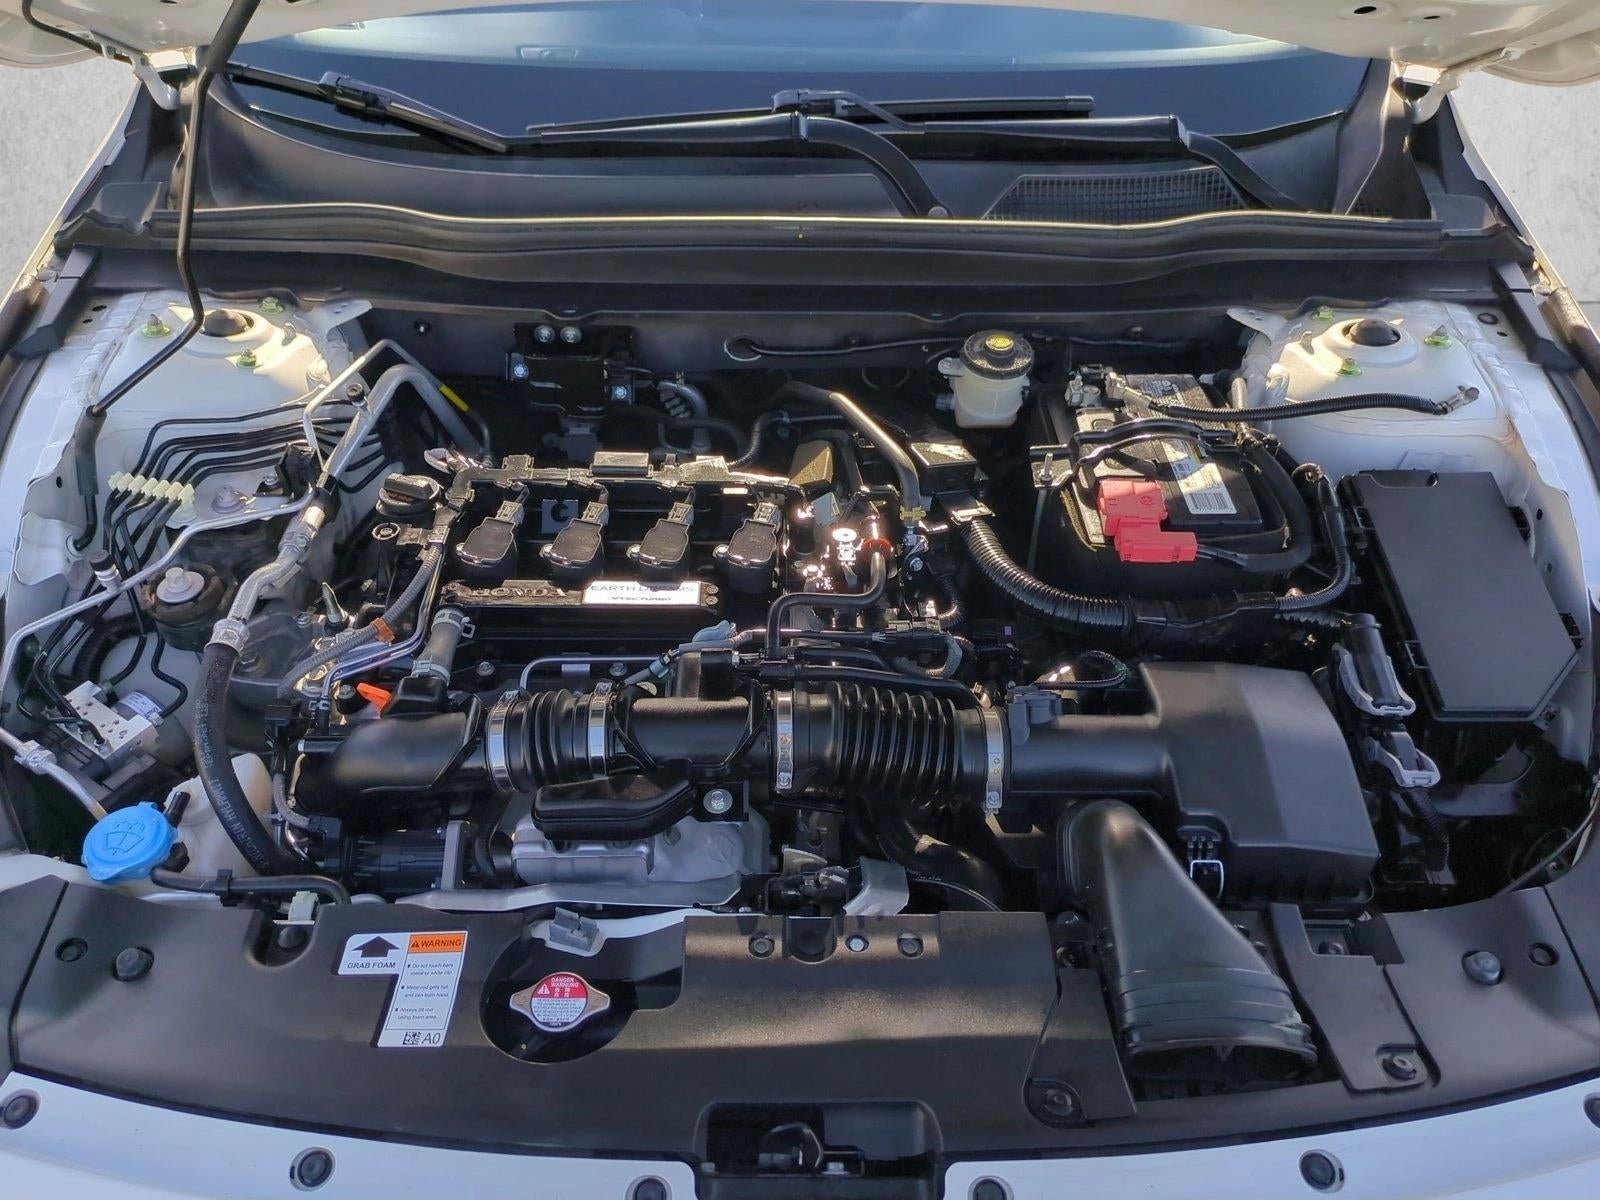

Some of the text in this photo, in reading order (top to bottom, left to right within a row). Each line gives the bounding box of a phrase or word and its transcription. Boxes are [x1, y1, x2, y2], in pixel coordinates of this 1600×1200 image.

[472, 587, 567, 597] HONDA
[421, 939, 462, 947] WARNING
[421, 1032, 441, 1044] A0
